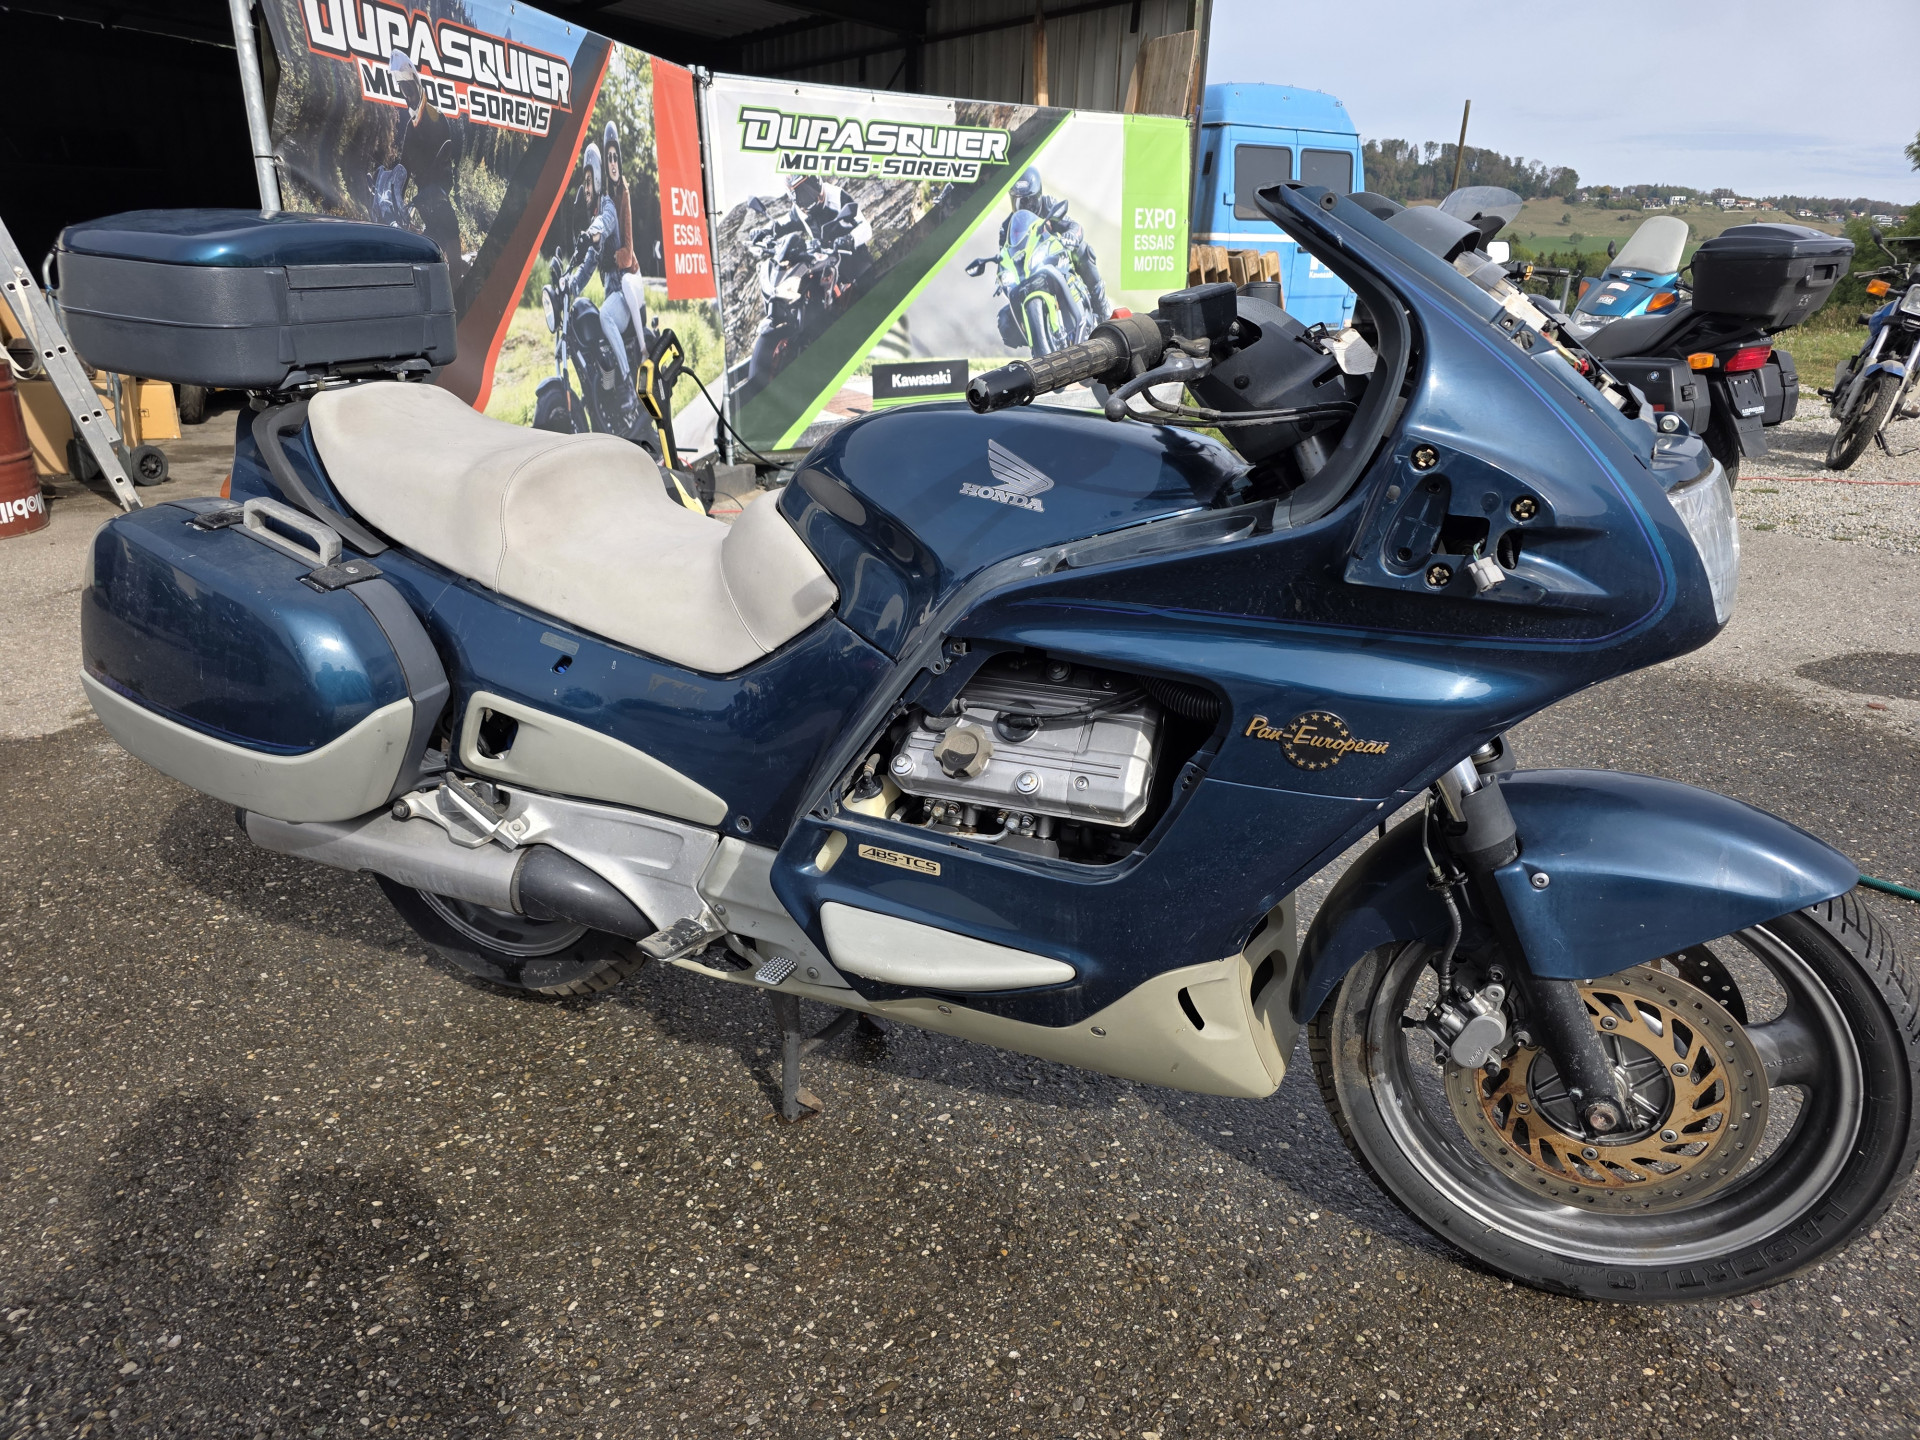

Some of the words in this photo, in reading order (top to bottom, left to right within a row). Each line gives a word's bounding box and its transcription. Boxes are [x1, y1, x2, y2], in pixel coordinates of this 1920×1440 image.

[742, 109, 1008, 161] DUPASQUIER
[1134, 207, 1176, 229] EXPO
[1133, 234, 1175, 251] ESSAIS
[1133, 255, 1175, 272] MOTOS
[891, 368, 952, 388] Kawasaki
[959, 482, 1045, 513] HONDA
[1245, 715, 1390, 757] Pan-European
[862, 847, 938, 872] ABS-TCS
